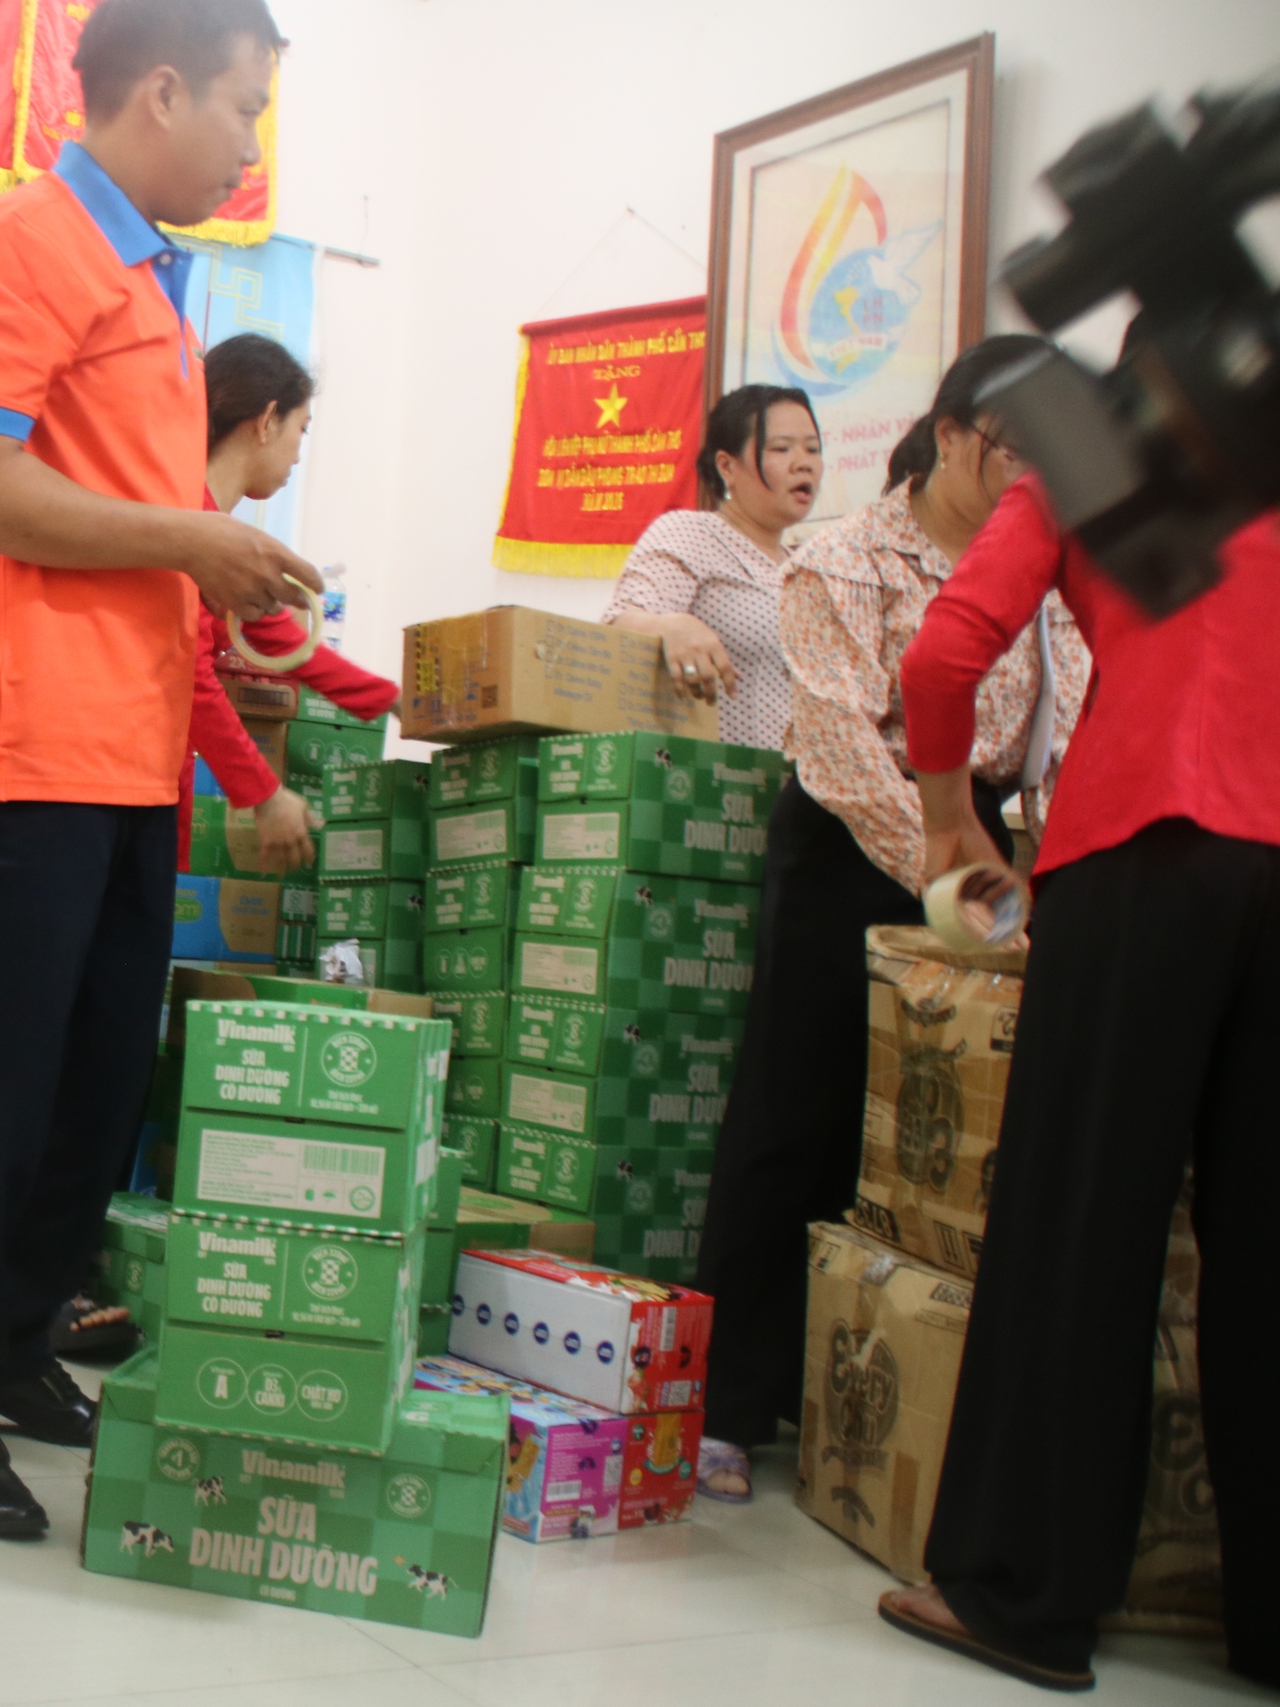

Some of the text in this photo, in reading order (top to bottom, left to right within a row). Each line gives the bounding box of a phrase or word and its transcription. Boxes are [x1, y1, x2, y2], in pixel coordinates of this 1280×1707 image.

[218, 1017, 296, 1045] Vinamilk
[215, 1064, 245, 1082] DINH
[199, 1231, 277, 1258] Vinamilk
[197, 1277, 226, 1296] DINH
[243, 1449, 346, 1489] Vinamilk
[257, 1493, 317, 1543] SỮA
[189, 1527, 379, 1597] DINH DƯỠNG
